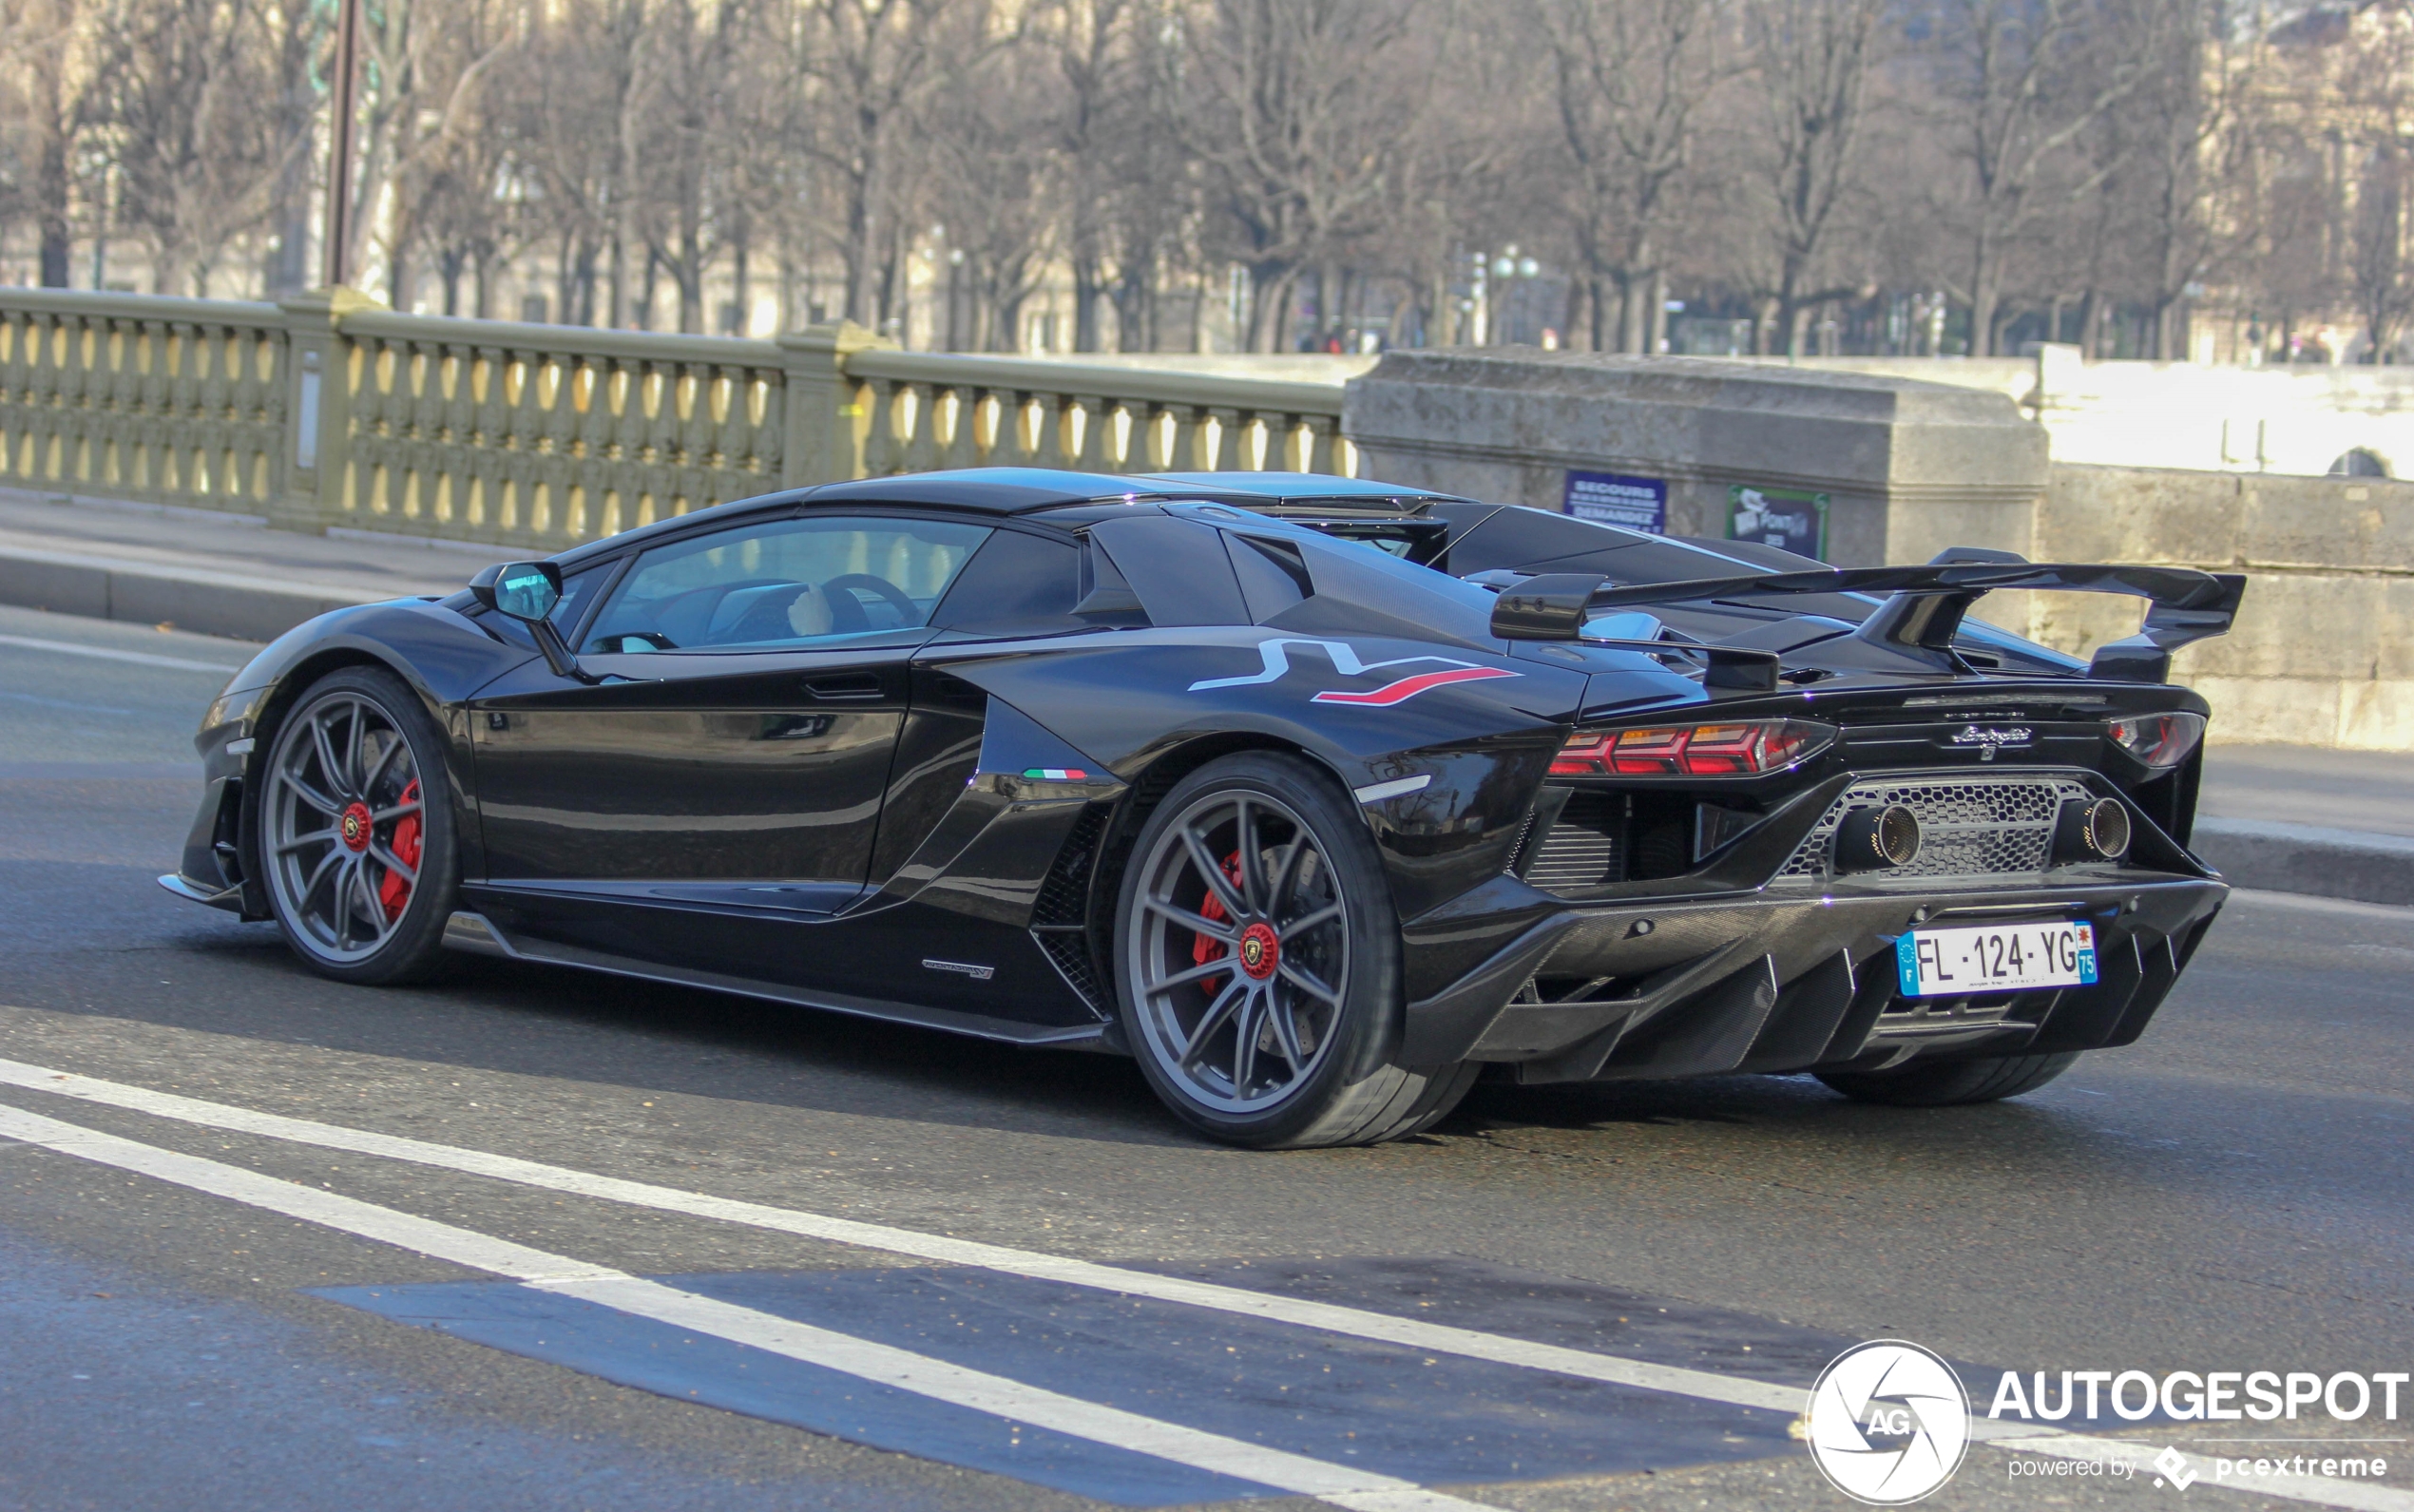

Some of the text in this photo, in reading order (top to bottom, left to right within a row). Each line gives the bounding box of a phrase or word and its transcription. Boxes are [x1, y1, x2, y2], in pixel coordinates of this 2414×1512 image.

[1575, 480, 1656, 499] SECOURS
[1574, 507, 1654, 526] DEMANDEZ
[2079, 955, 2095, 975] 75
[1906, 969, 1912, 982] F
